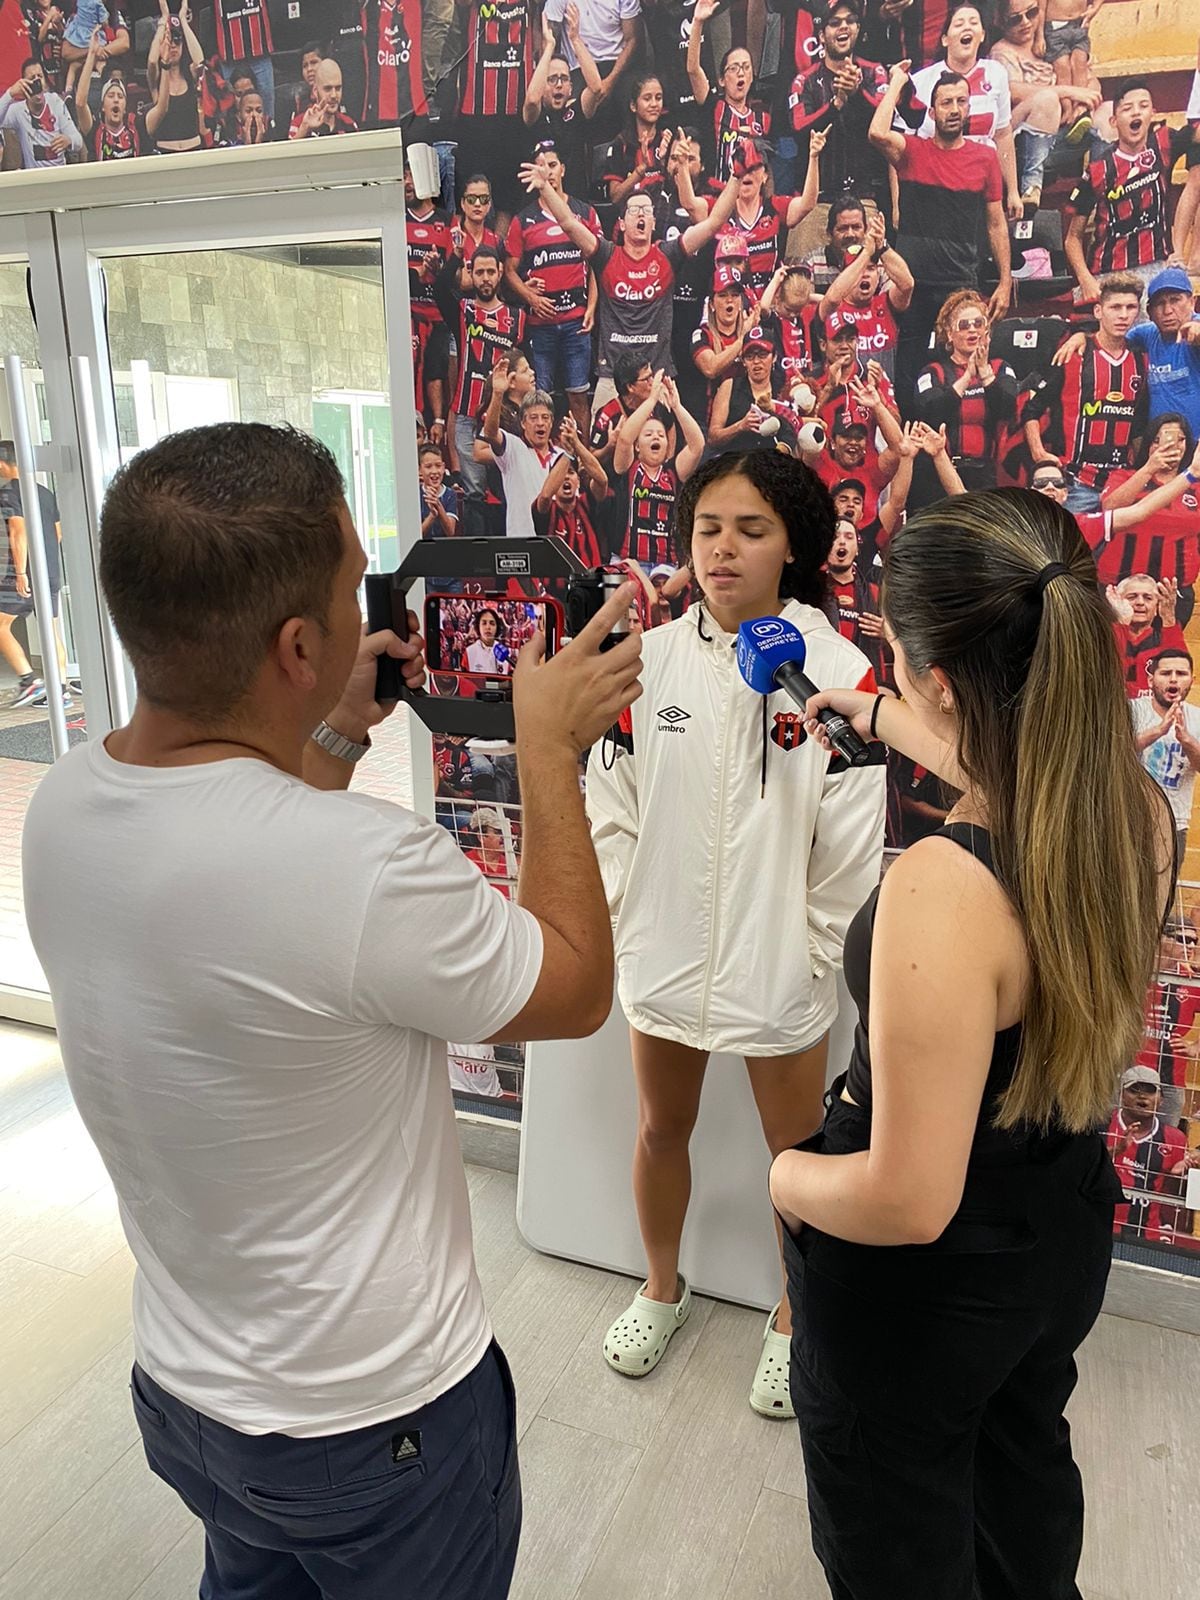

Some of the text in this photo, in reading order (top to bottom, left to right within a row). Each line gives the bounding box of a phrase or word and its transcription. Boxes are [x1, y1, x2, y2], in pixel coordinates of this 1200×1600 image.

[496, 6, 525, 20] movistar
[377, 44, 412, 66] Claro
[1125, 171, 1160, 193] movistar
[748, 241, 773, 252] ovistar
[549, 249, 582, 261] movistar
[614, 280, 659, 300] Claro
[483, 331, 512, 348] movistar
[610, 332, 659, 343] BRIDGESTONE
[757, 632, 797, 647] DEPORTES
[760, 637, 800, 651] REPRETEL
[658, 724, 686, 734] umbro
